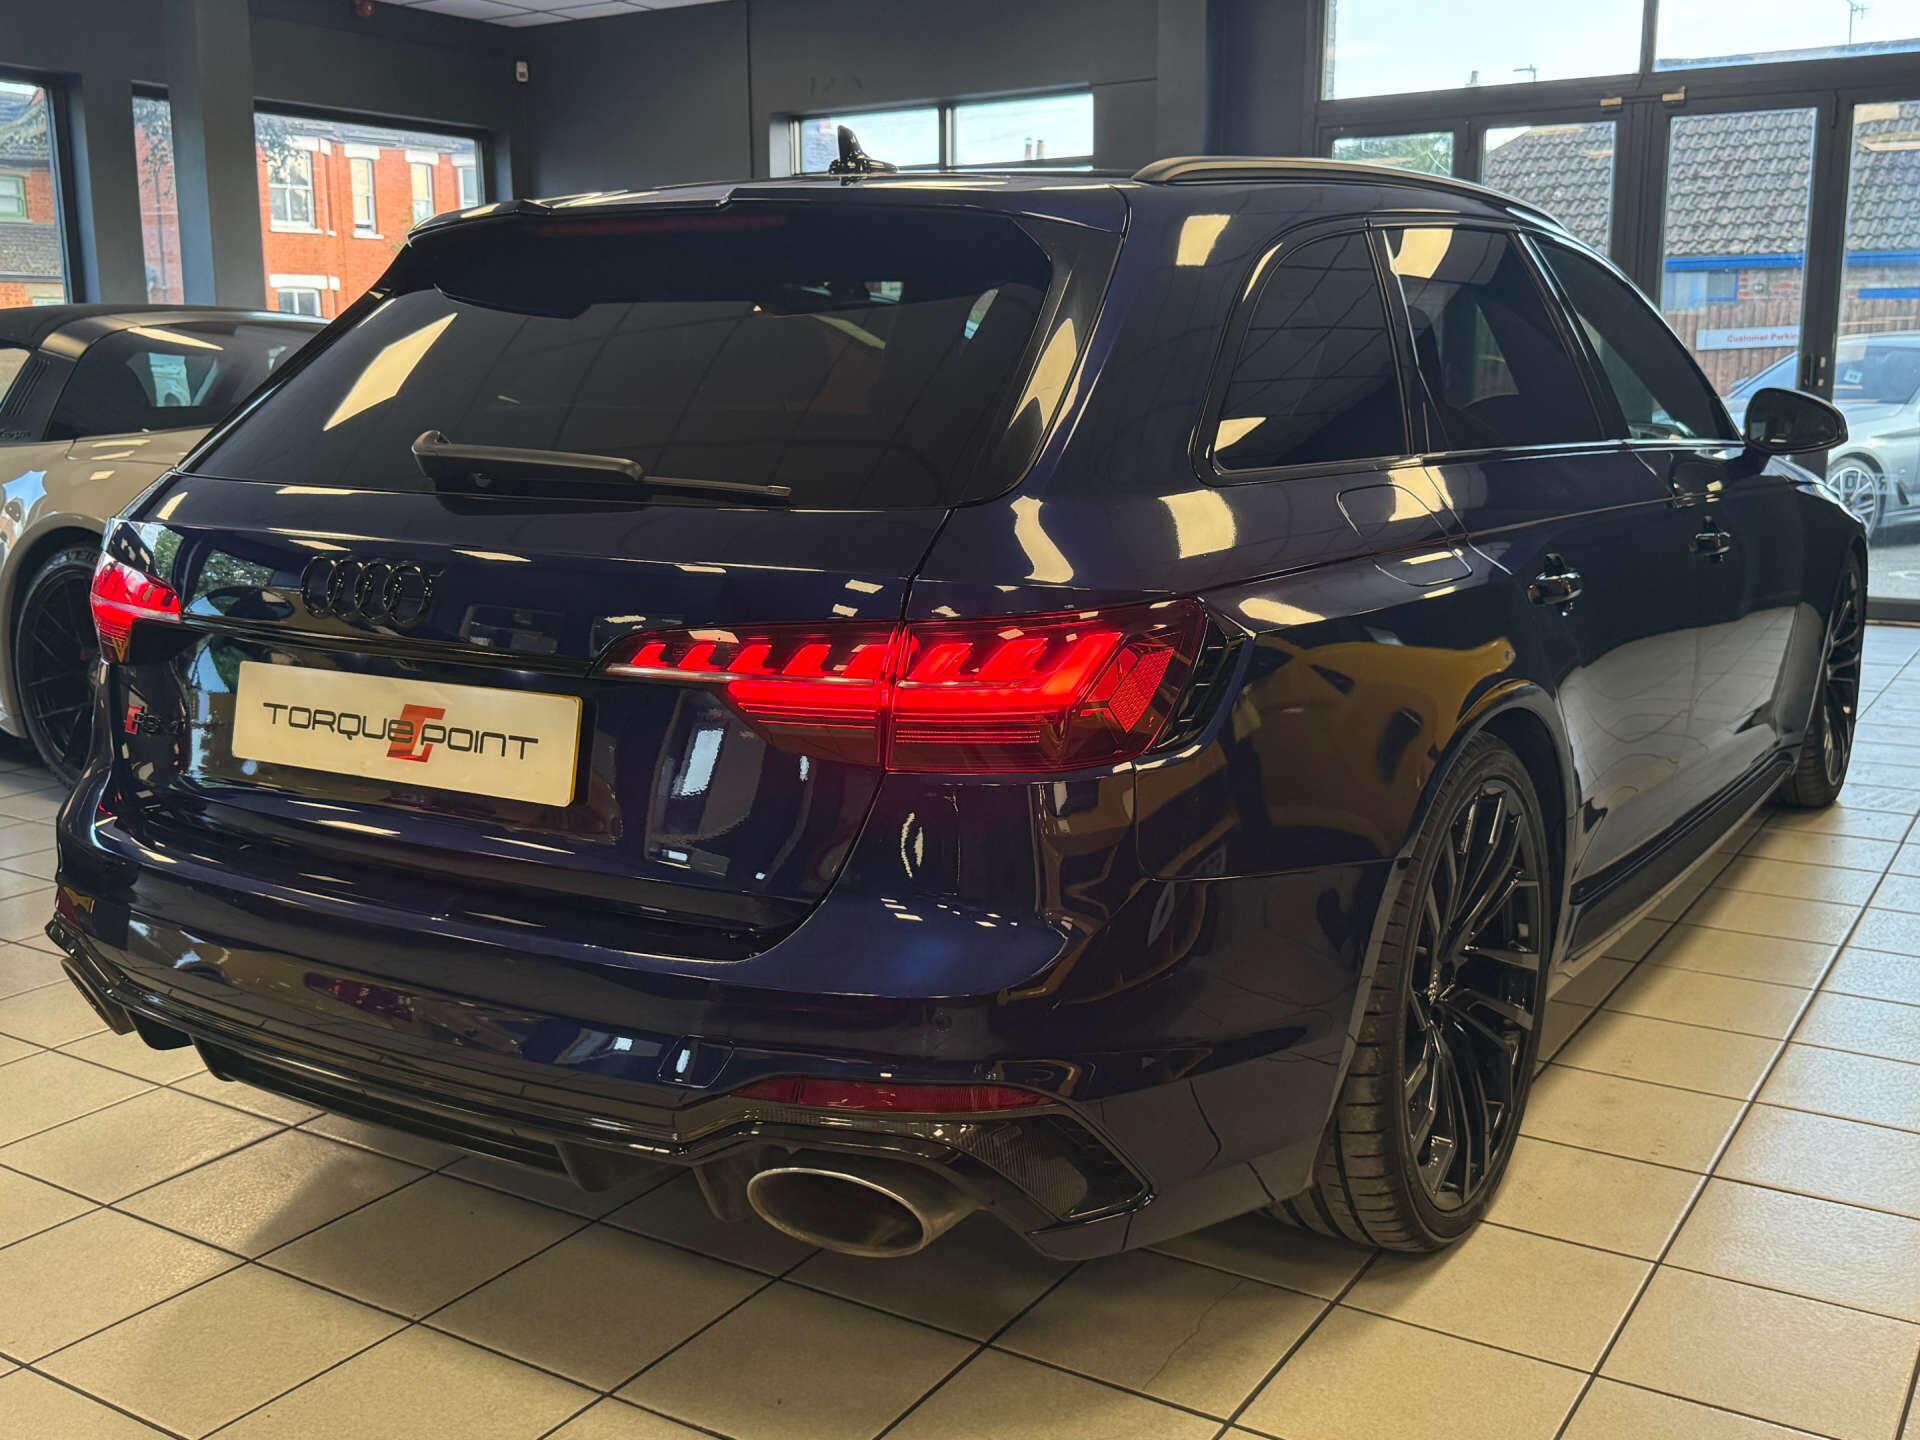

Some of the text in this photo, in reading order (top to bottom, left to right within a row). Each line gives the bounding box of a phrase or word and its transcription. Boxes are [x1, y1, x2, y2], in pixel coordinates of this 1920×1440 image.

[1727, 334, 1768, 343] Customer
[263, 702, 539, 760] TORQUE POINT
